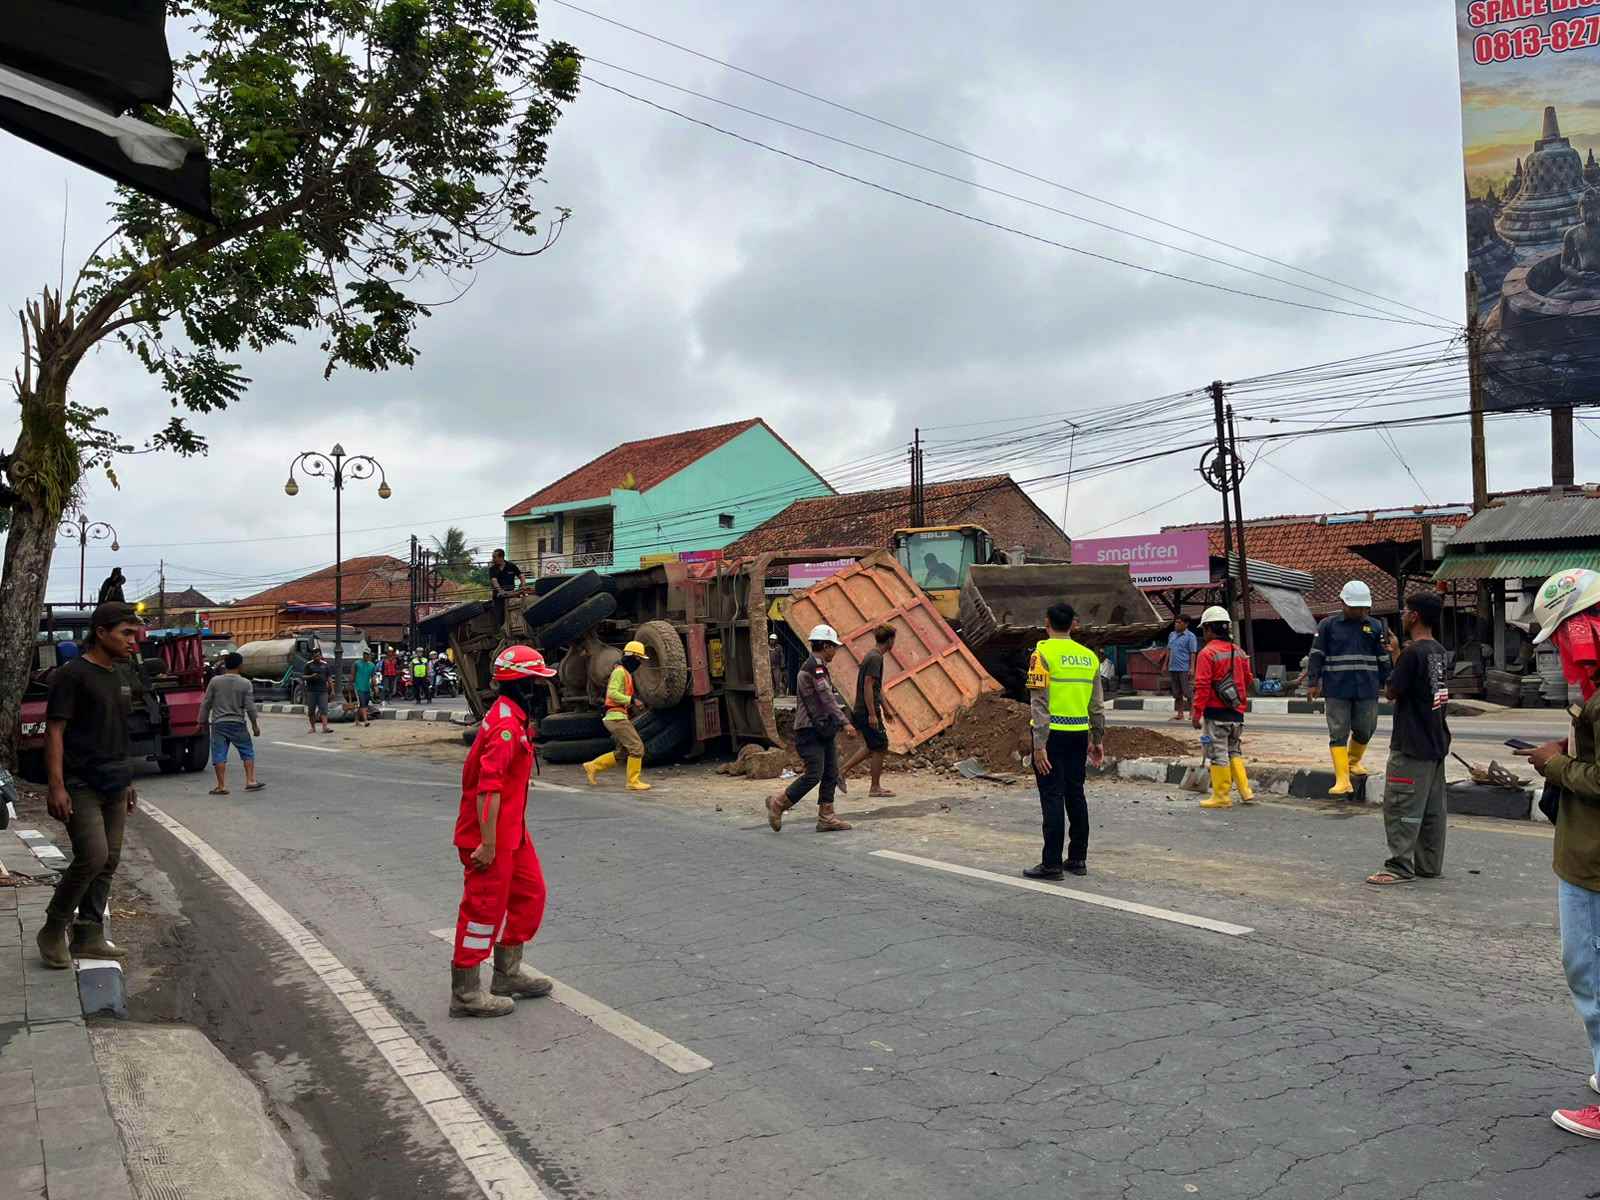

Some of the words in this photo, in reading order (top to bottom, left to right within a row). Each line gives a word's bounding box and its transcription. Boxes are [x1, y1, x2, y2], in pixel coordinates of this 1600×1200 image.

[1469, 0, 1548, 26] SPACE
[1474, 15, 1600, 63] 0813-827
[1097, 542, 1178, 562] smartfren
[1137, 575, 1173, 584] HARTONO
[1061, 655, 1092, 666] POLISI
